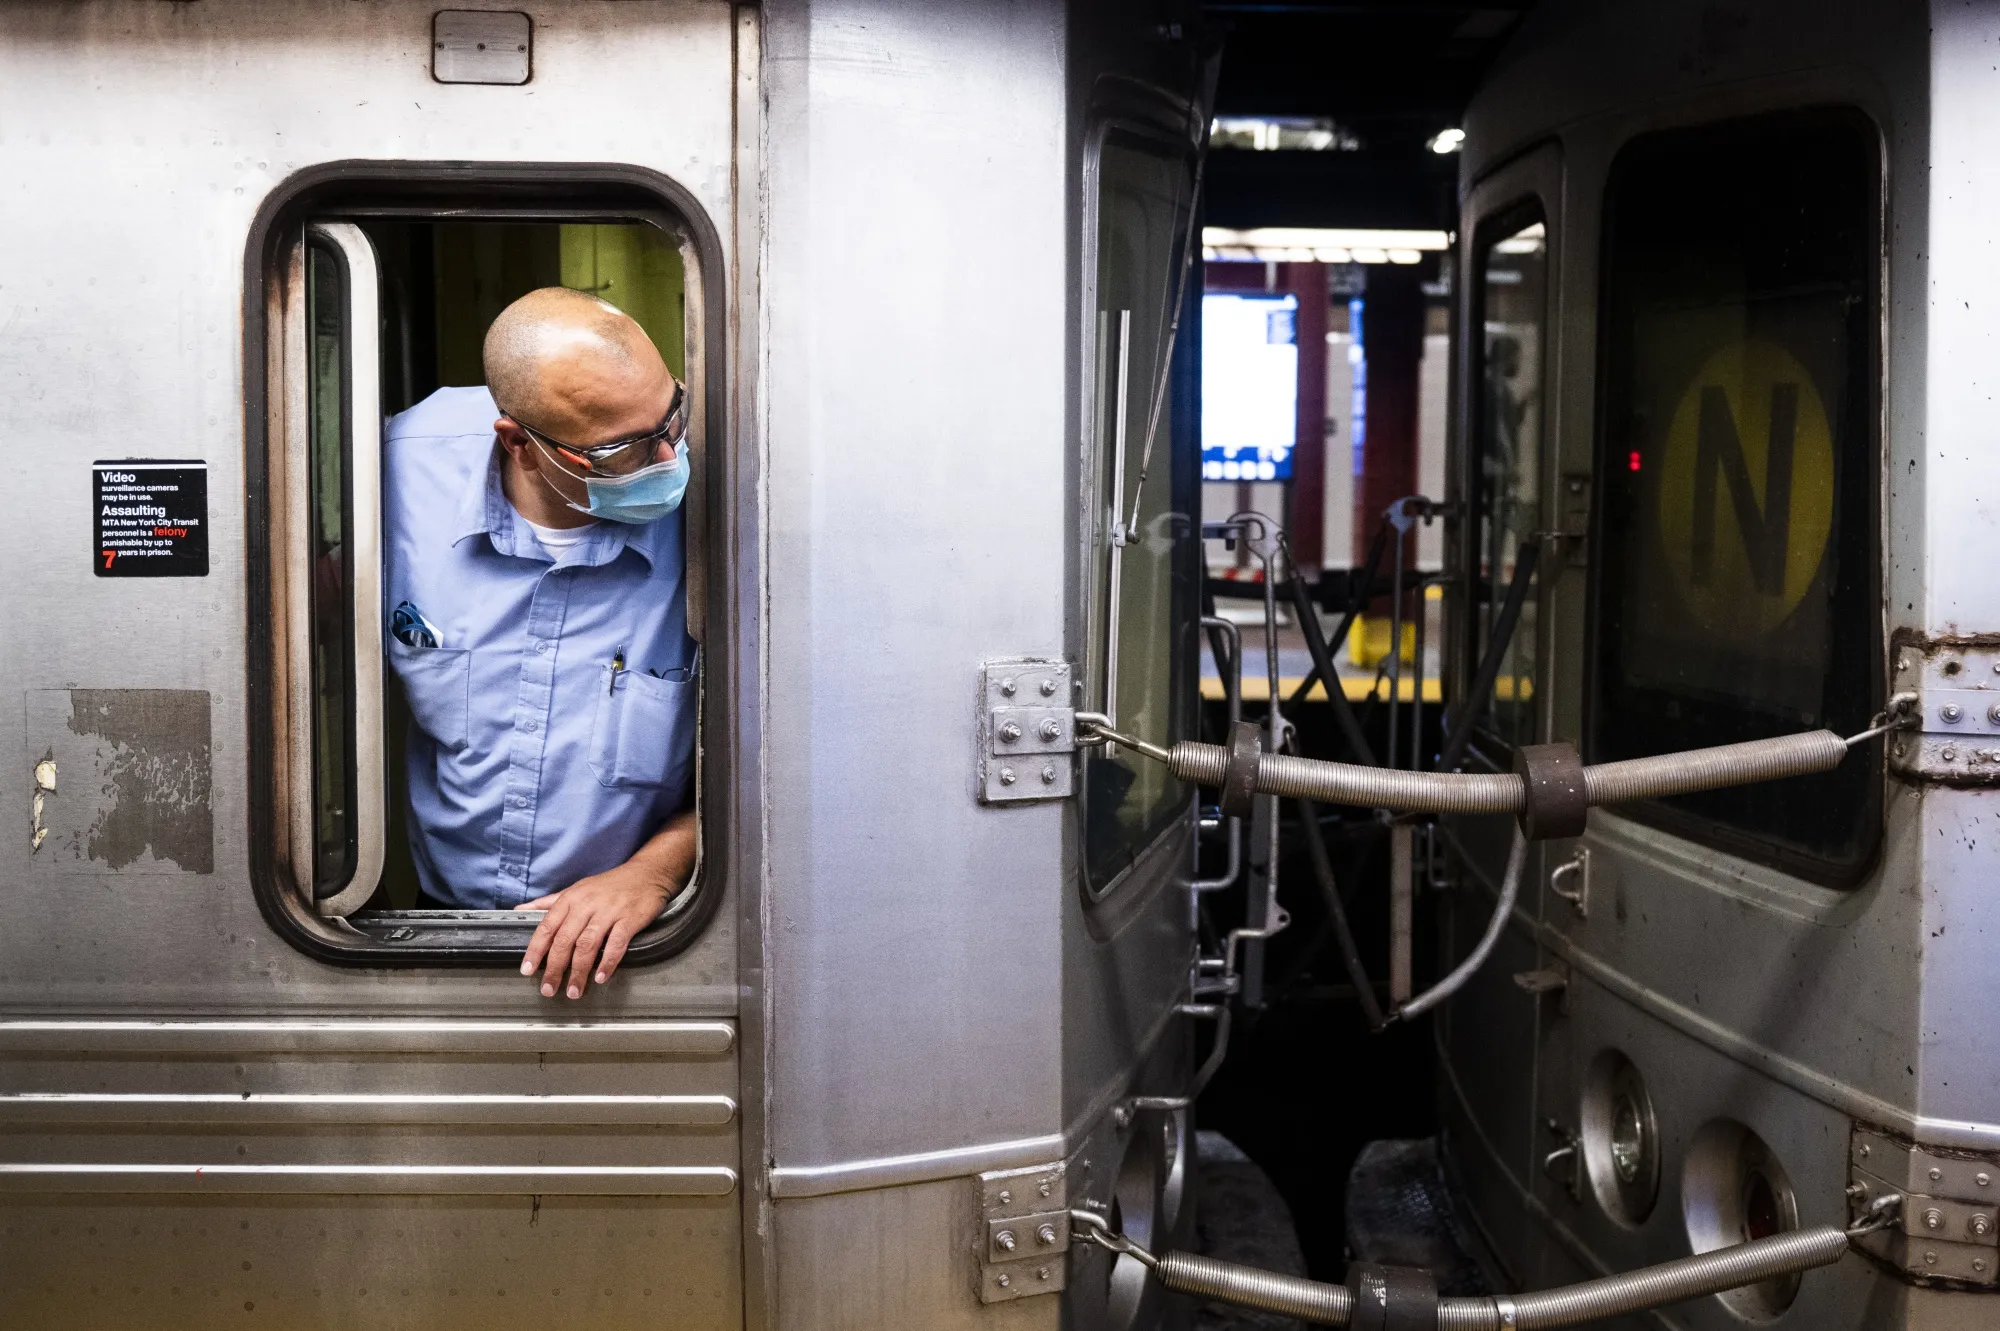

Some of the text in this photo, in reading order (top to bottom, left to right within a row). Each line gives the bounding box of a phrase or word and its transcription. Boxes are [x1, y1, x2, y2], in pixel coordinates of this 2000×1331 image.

[102, 472, 136, 482] Video
[1690, 383, 1799, 596] N
[102, 505, 166, 517] Assaulting
[102, 530, 139, 538] personnel
[154, 527, 187, 538] felony
[102, 550, 116, 568] 7
